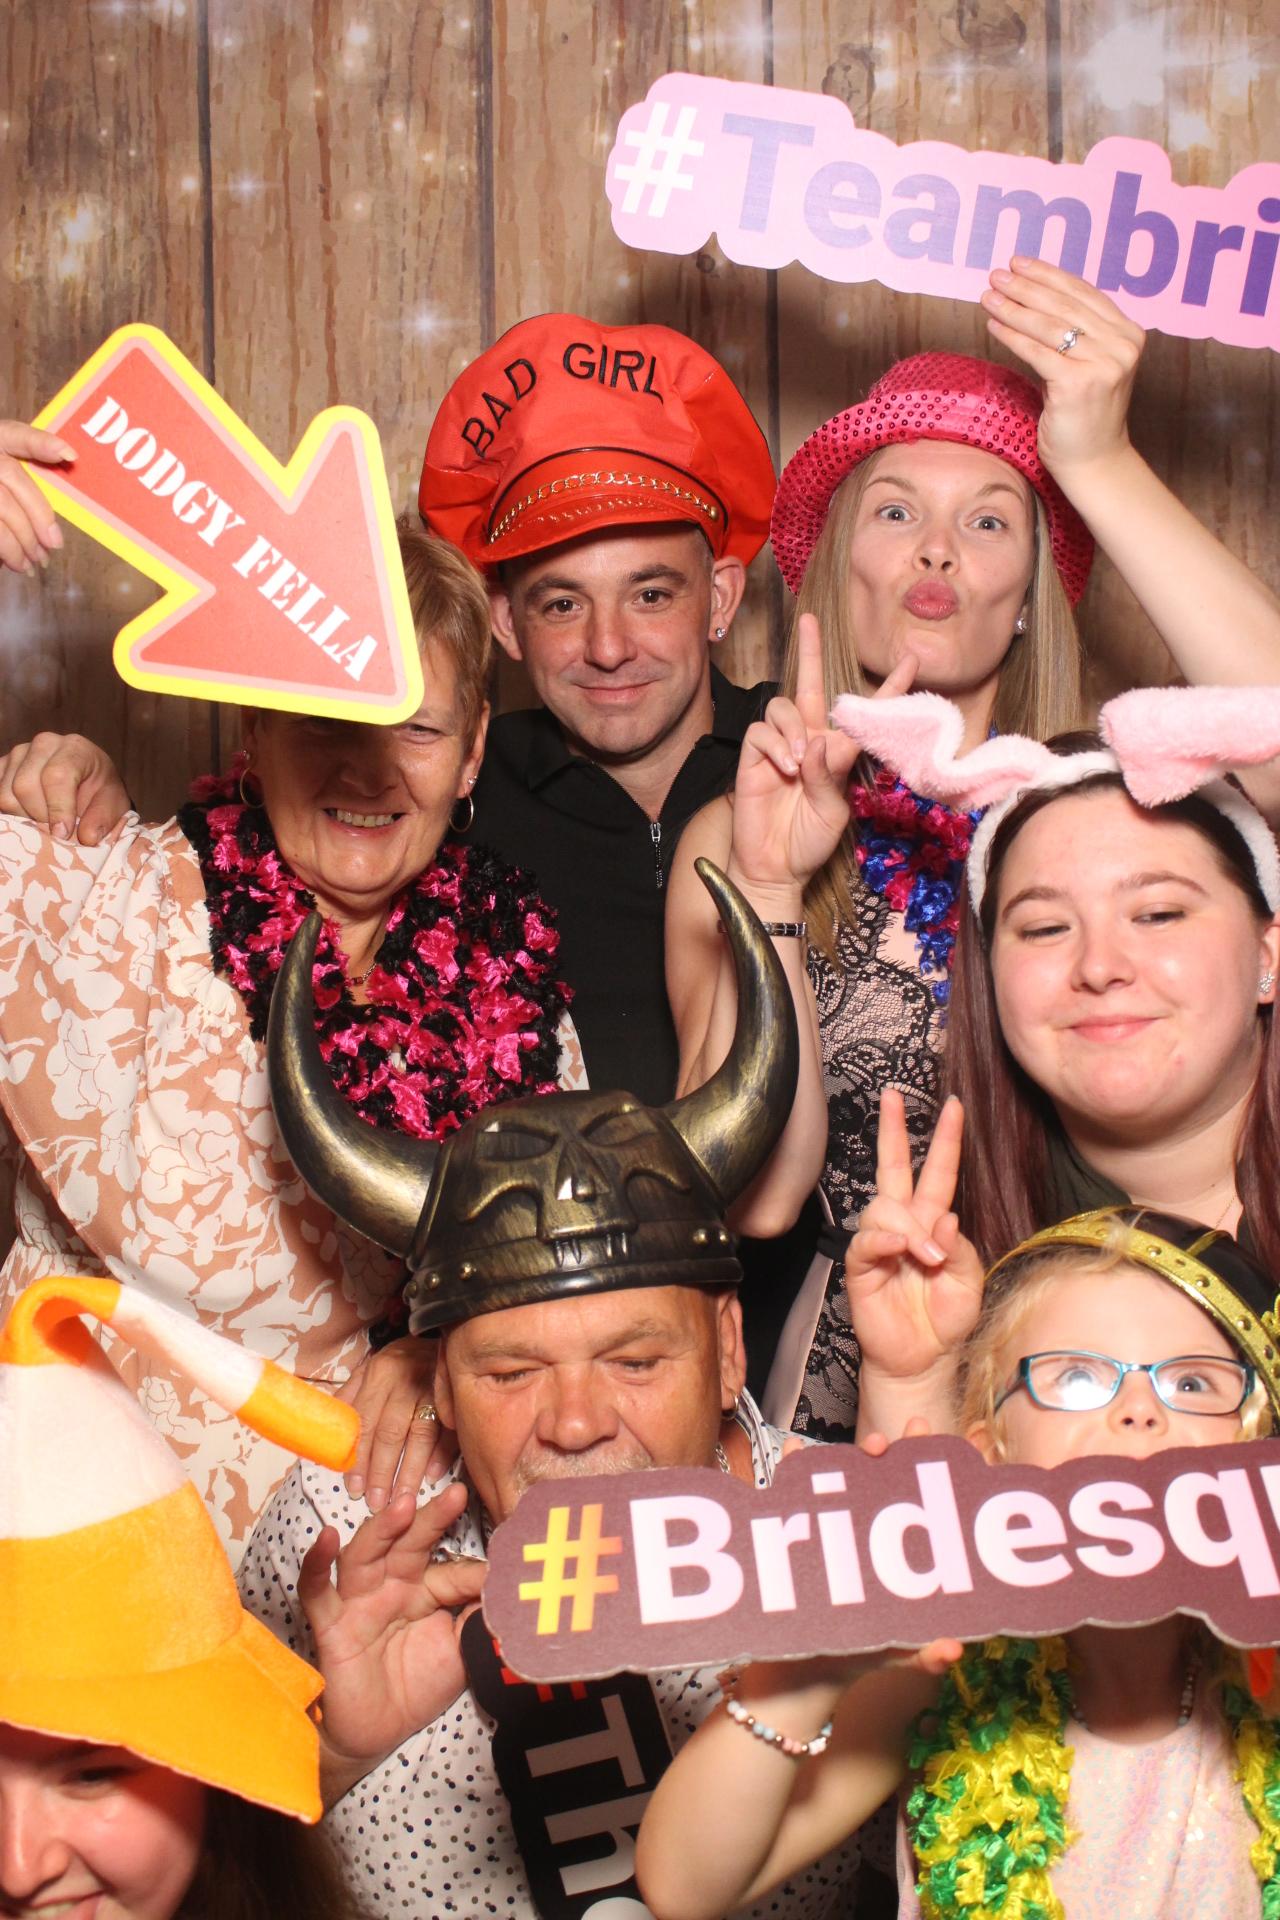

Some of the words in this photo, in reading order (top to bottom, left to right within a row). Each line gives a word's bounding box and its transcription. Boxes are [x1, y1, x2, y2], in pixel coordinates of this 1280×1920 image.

[461, 357, 538, 458] BAD
[562, 342, 664, 405] GIRL
[81, 396, 246, 548] DODGY
[232, 534, 378, 681] FELLA
